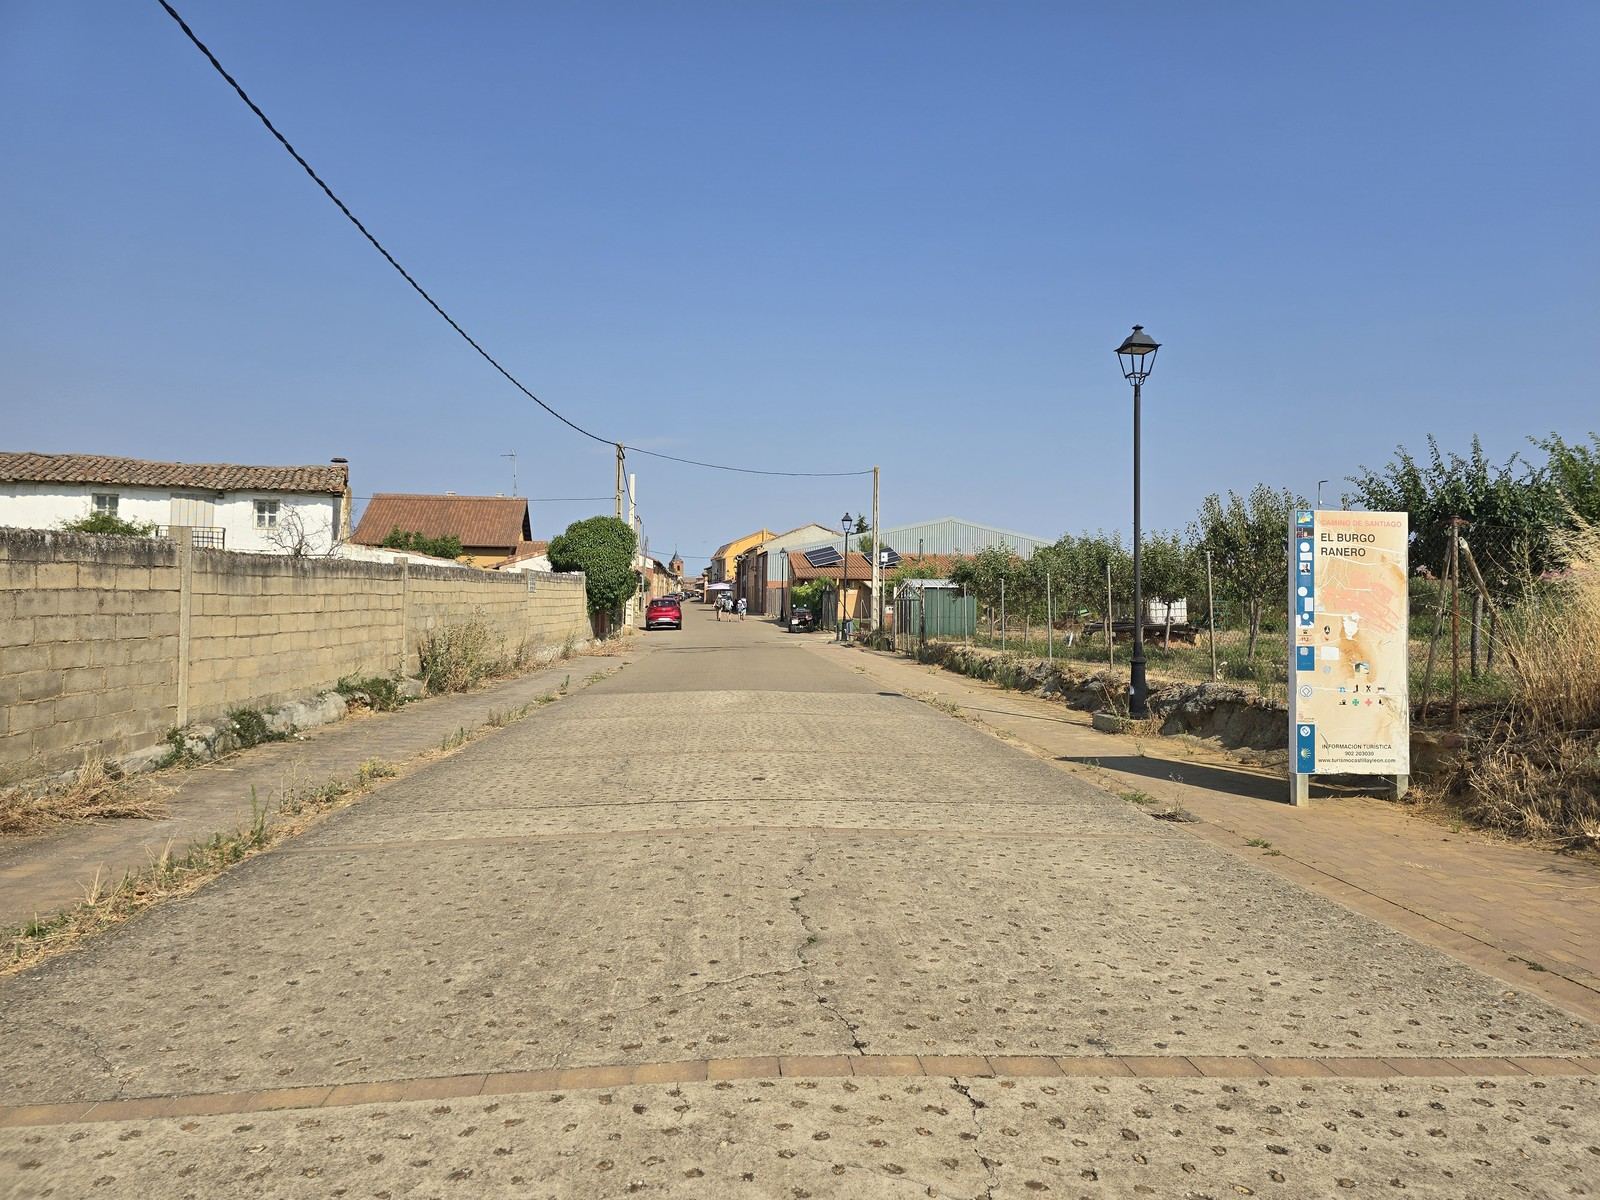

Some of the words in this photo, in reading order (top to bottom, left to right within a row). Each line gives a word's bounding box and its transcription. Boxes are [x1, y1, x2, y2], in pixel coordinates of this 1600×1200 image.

[1365, 520, 1402, 528] SANTIAGO
[1320, 533, 1334, 542] EL
[1337, 533, 1376, 543] BURGO
[1320, 547, 1366, 557] RANERO
